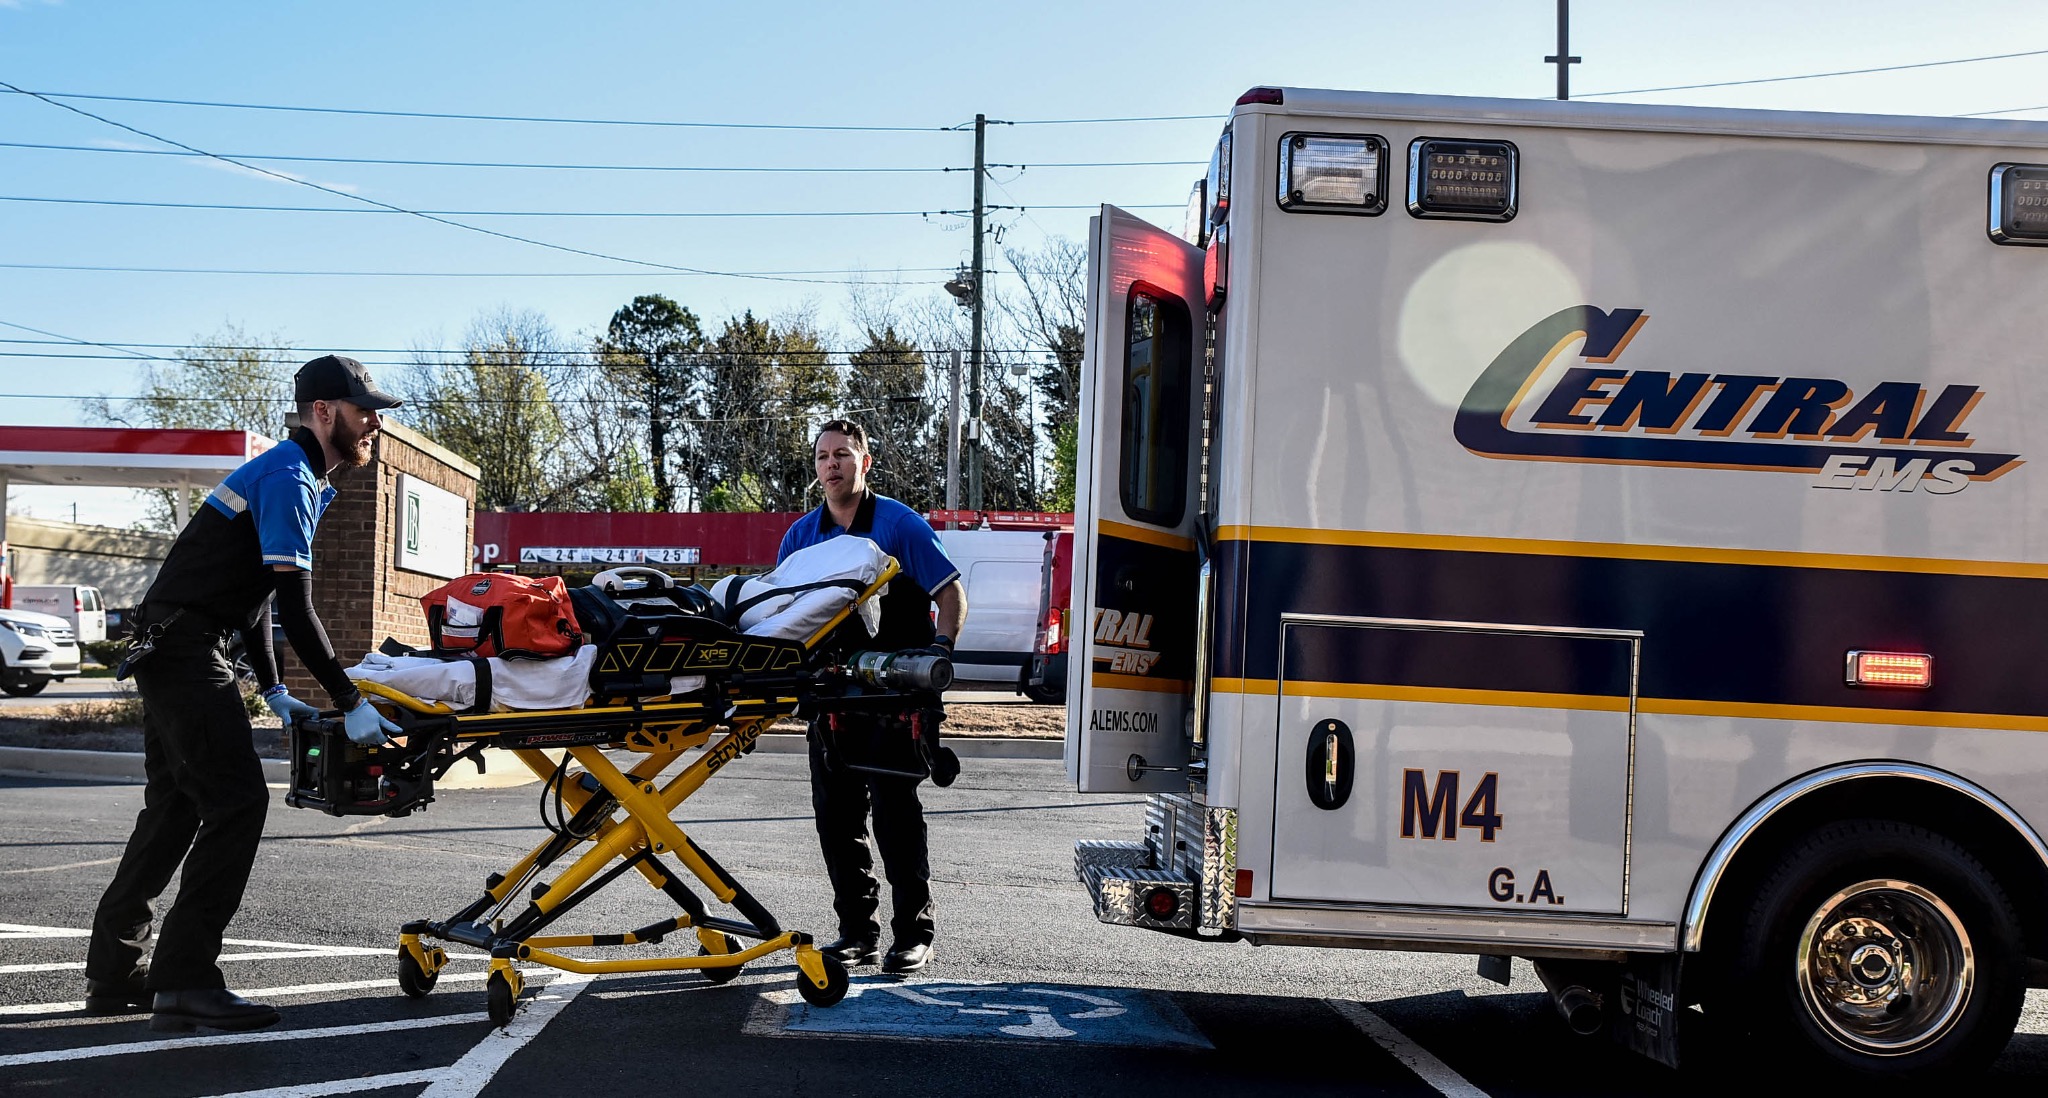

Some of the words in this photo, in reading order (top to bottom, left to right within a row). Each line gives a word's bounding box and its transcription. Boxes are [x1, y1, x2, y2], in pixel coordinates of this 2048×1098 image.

[1453, 304, 1986, 468] CENTRAL
[1812, 453, 1977, 496] EMS
[699, 648, 729, 661] XPS
[1110, 651, 1150, 675] EMS
[1089, 709, 1158, 733] ALEMS.COM
[706, 717, 766, 775] stryker
[1400, 768, 1503, 842] M4
[1488, 866, 1565, 905] G.A.
[1637, 978, 1674, 1012] Wheeled
[1636, 999, 1661, 1028] Coach
